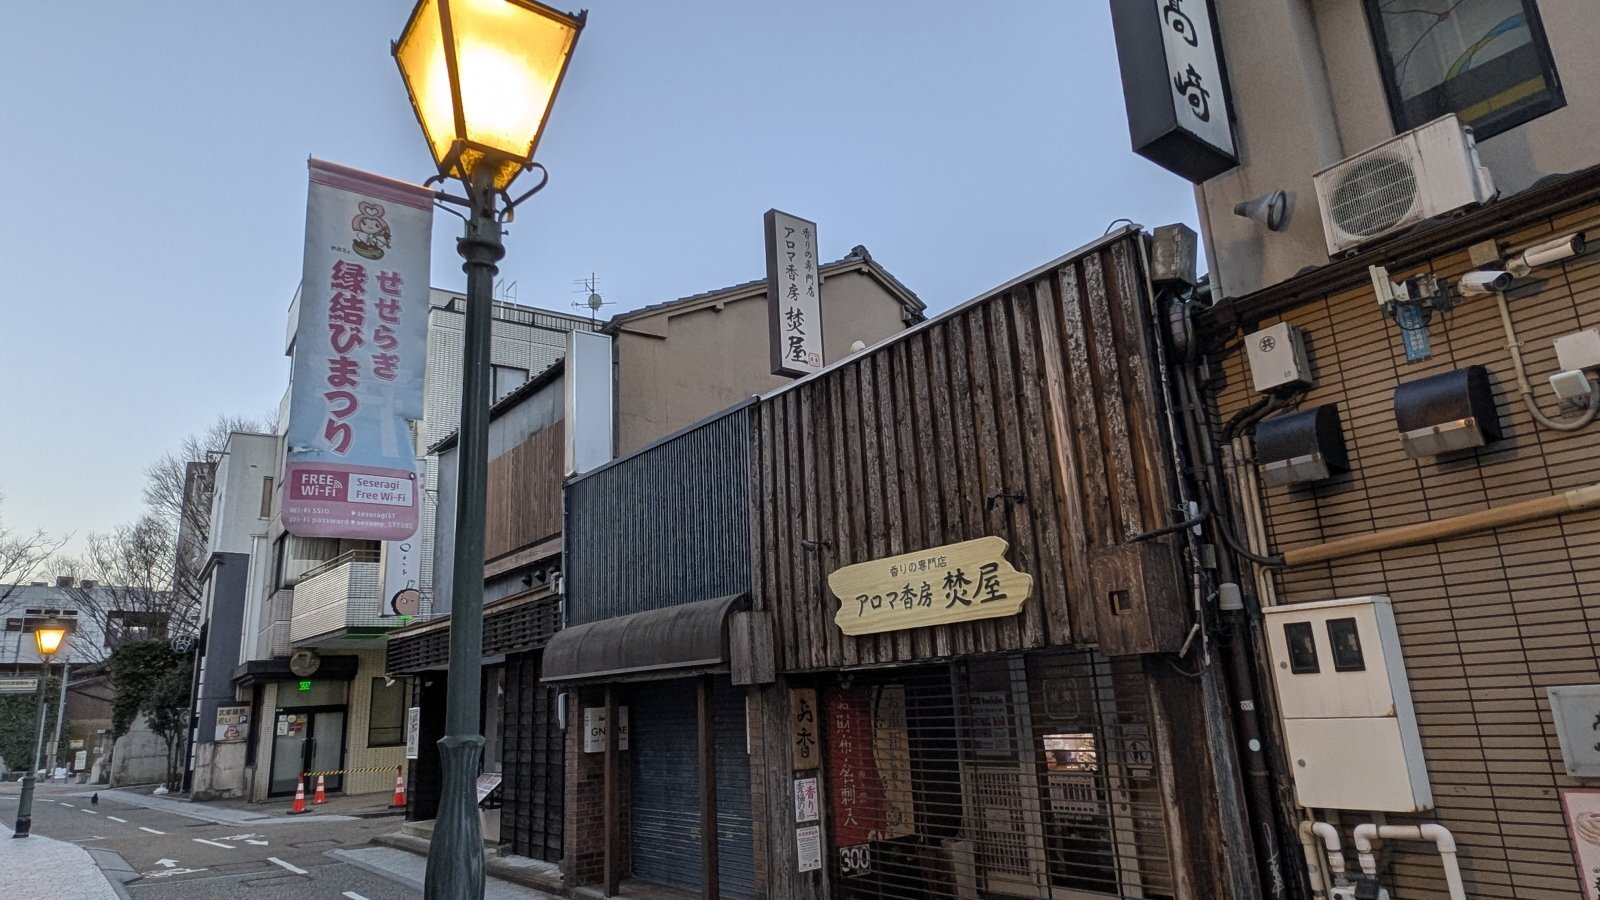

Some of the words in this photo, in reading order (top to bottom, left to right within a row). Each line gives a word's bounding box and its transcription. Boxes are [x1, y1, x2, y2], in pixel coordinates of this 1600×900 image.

[784, 226, 800, 302] アロマ香房
[802, 228, 815, 298] 香りの専門店
[371, 270, 402, 380] せせらぎ
[784, 306, 808, 365] 焚屋
[324, 259, 367, 456] 縁結びまつり
[301, 473, 335, 485] FREE
[301, 485, 336, 497] Wi-Fi
[356, 478, 400, 490] Seseragi
[356, 491, 379, 500] Free
[381, 492, 406, 502] Wi-Fi
[889, 555, 948, 577] 香りの専門店
[855, 580, 933, 617] アロマ香房
[941, 562, 1008, 609] 焚屋
[591, 726, 627, 736] GNE
[797, 698, 815, 758] お香
[840, 844, 869, 872] 300
